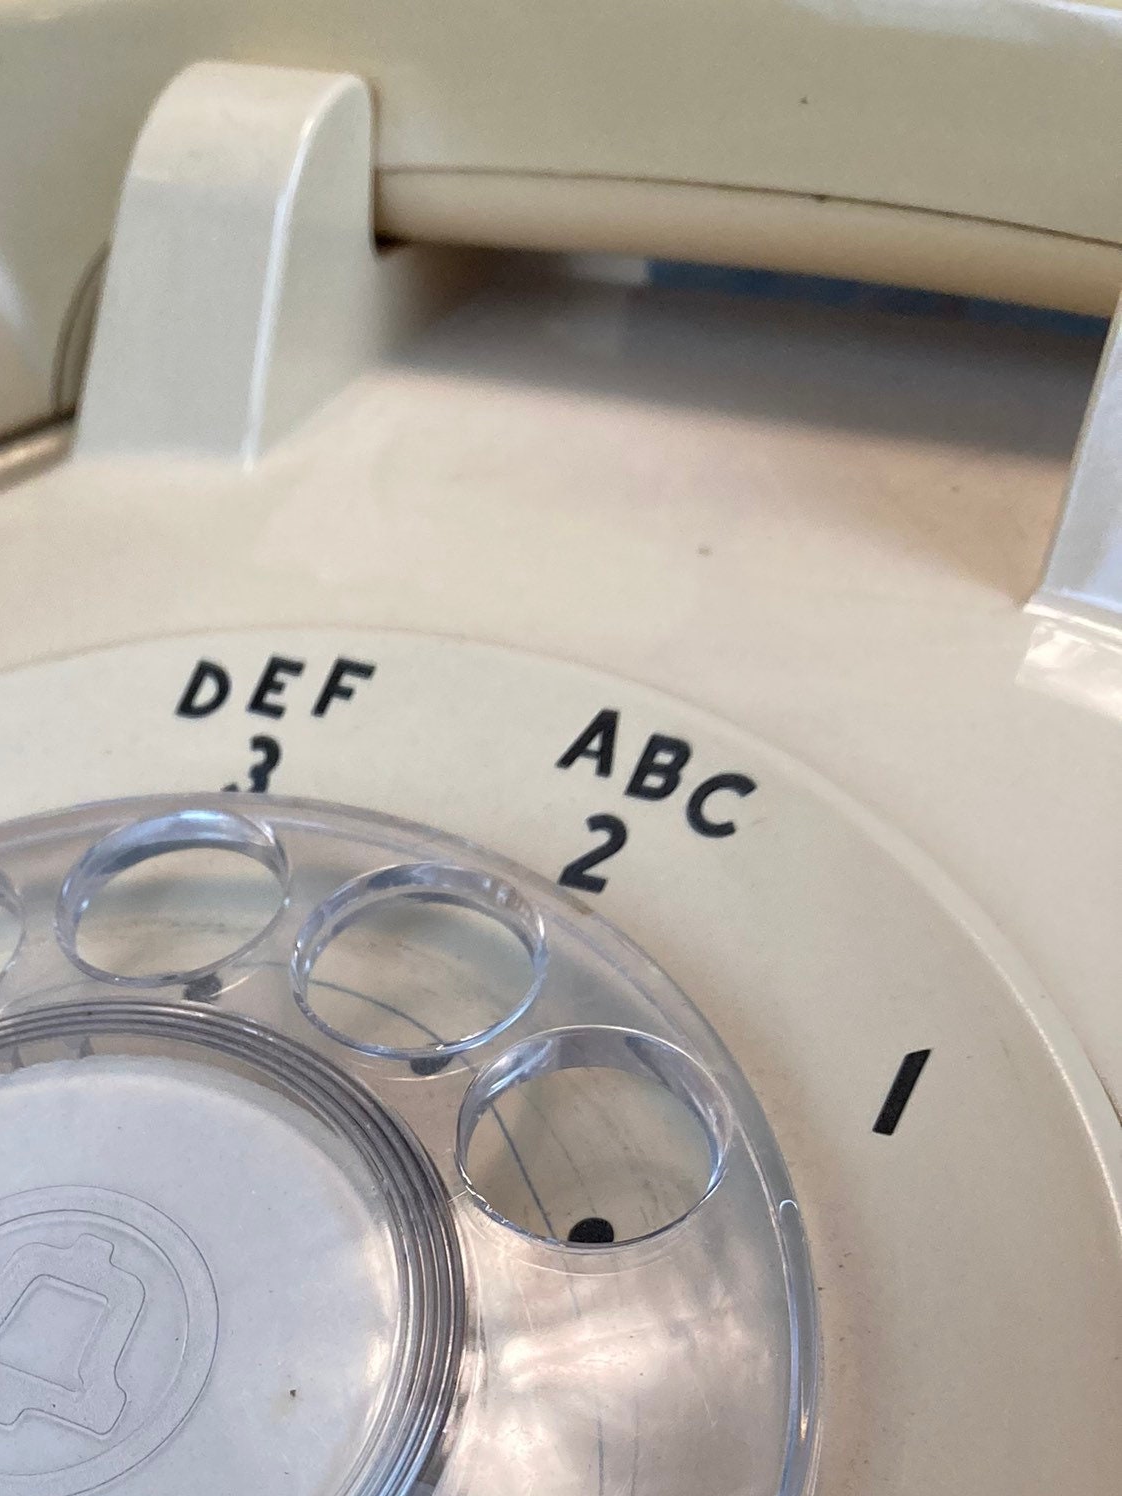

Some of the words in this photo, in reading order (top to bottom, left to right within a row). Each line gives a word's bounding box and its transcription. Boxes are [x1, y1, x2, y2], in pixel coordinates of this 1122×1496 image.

[175, 654, 376, 720] DEF
[556, 708, 758, 840] ABC
[557, 813, 629, 895] 2
[870, 1047, 933, 1138] 1
